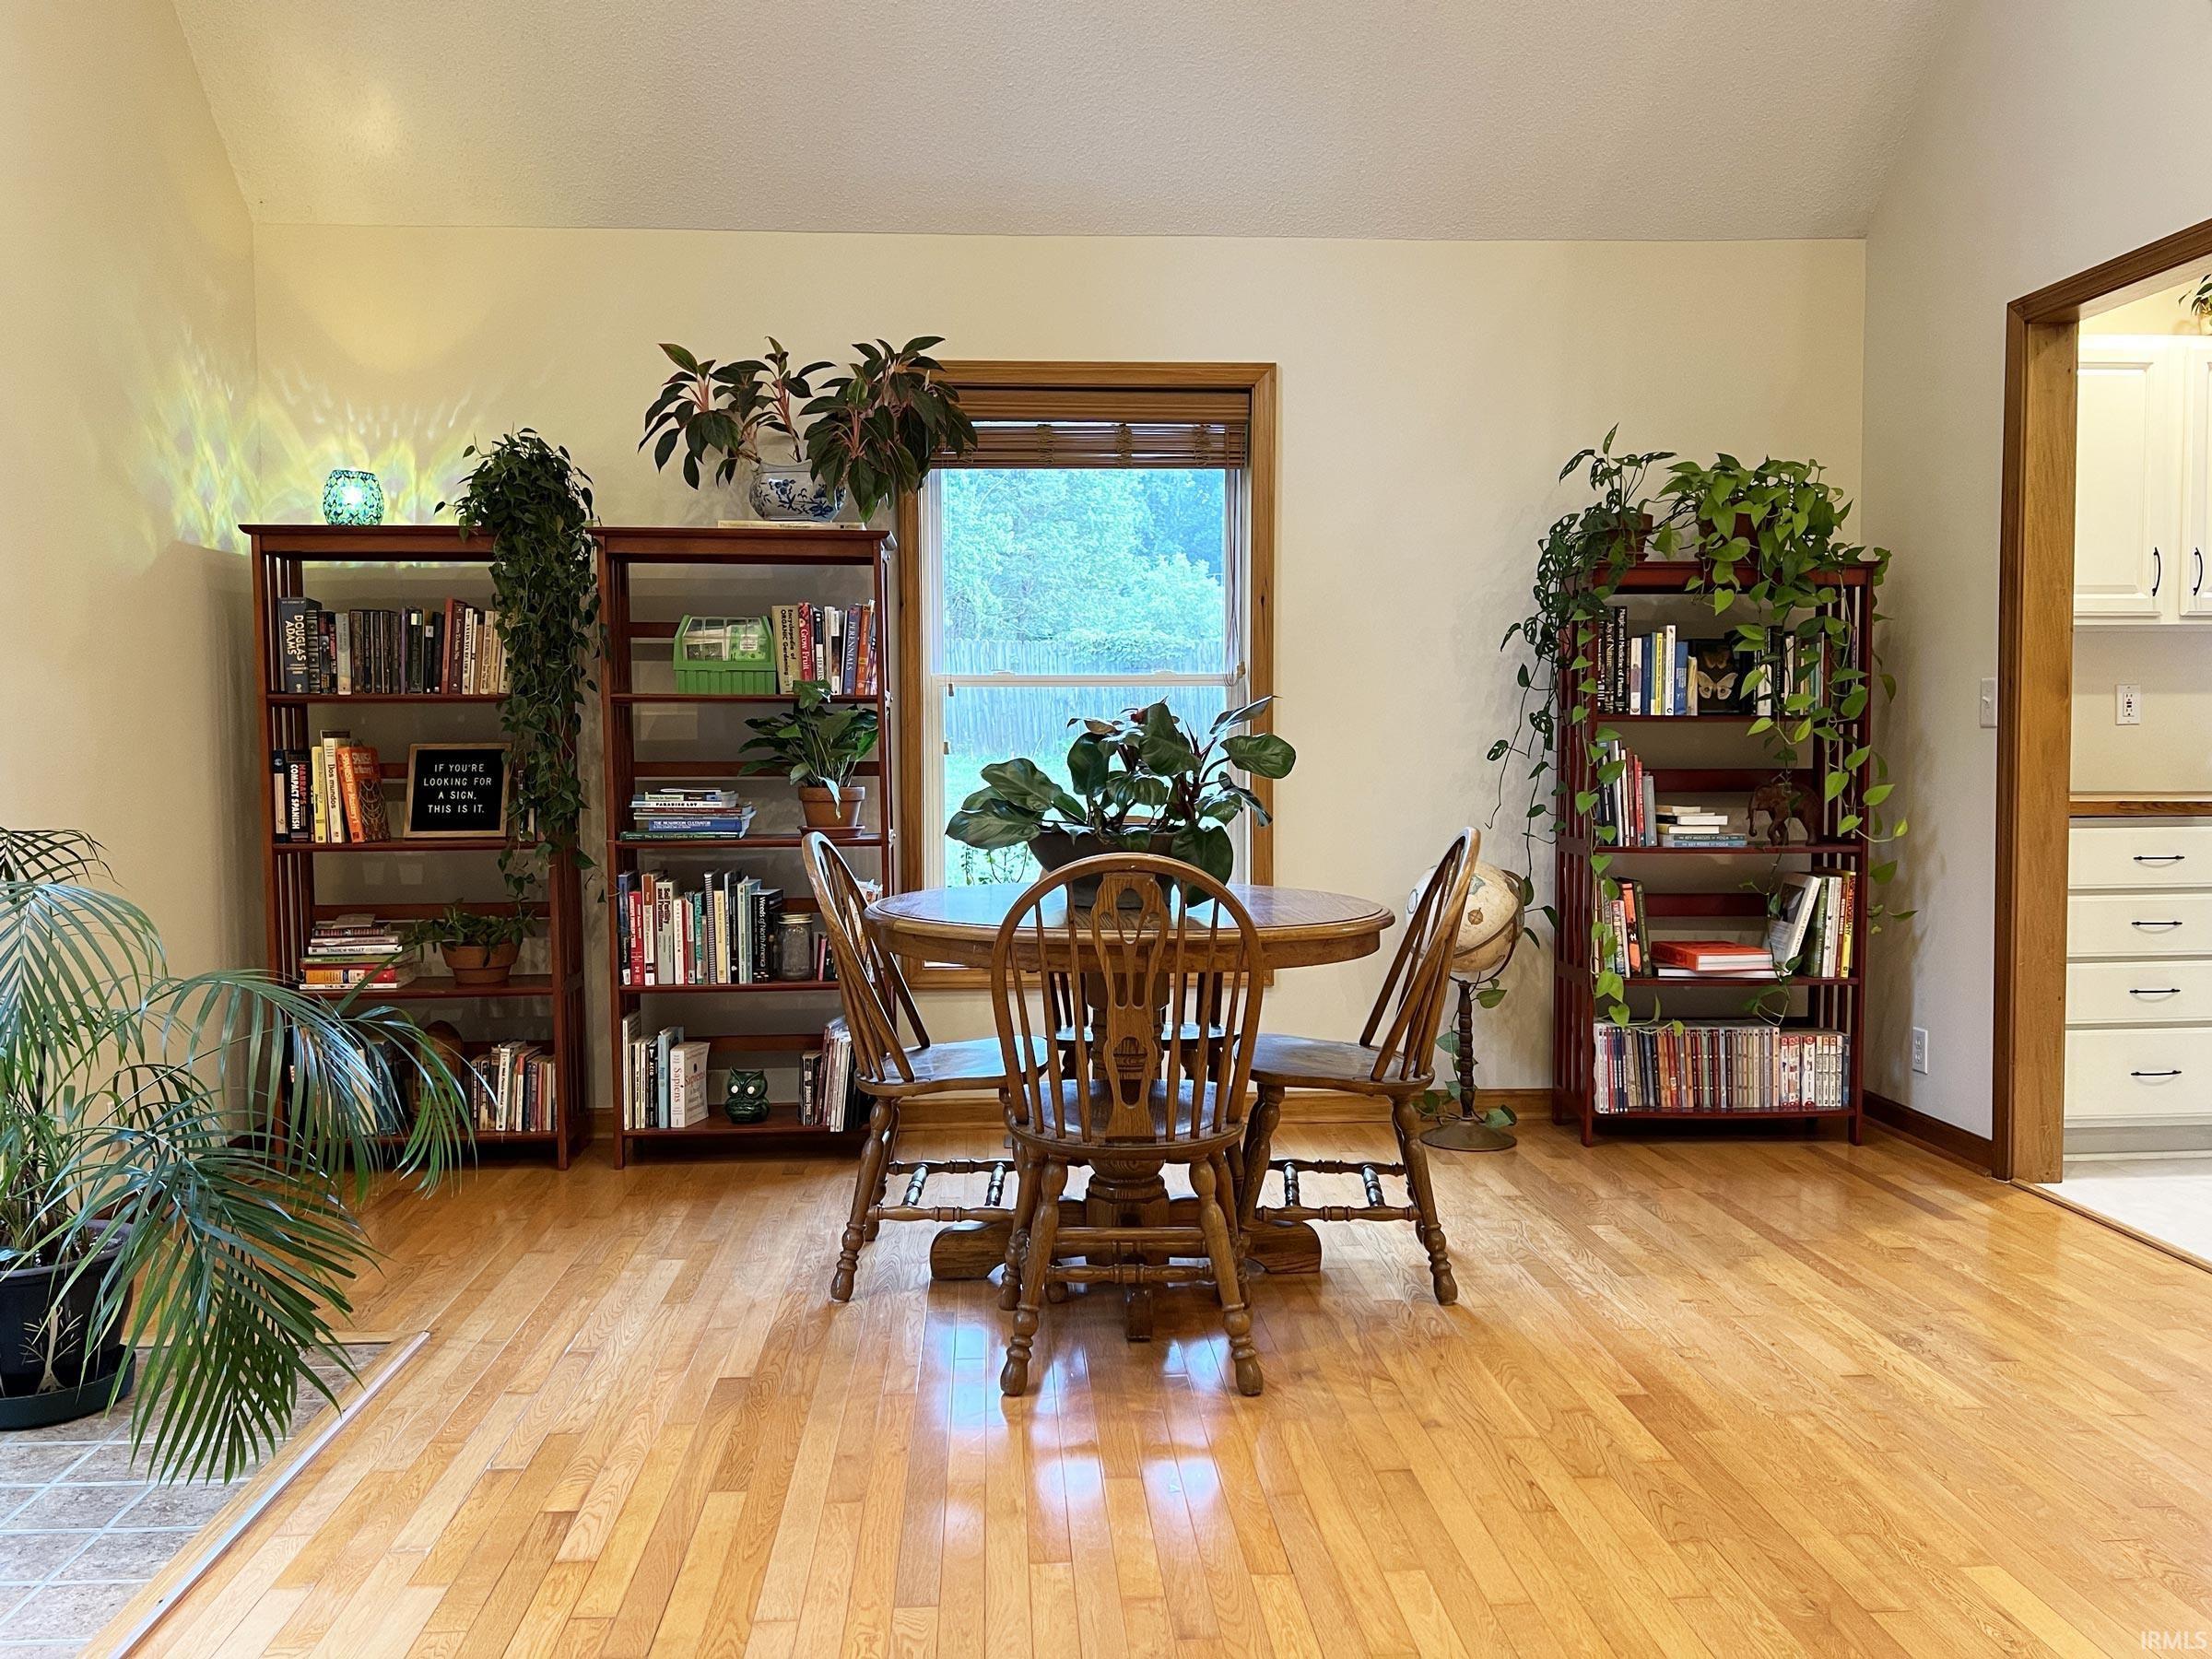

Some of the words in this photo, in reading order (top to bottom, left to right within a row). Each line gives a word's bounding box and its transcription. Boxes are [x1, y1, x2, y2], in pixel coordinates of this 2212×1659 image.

[788, 609, 797, 651] Encyclopedia
[1606, 622, 1614, 633] Joy
[1618, 608, 1626, 627] Magic
[285, 620, 296, 655] ADAMS
[294, 615, 306, 661] DOUGLAS
[846, 621, 855, 671] PERENNIALS
[290, 764, 300, 798] COMPACT
[423, 777, 467, 786] LOOKING
[473, 777, 492, 786] FOR
[434, 763, 444, 772] IF
[449, 763, 485, 772] YOU'RE
[299, 764, 307, 805] HARRAP'S
[438, 791, 444, 800] A
[450, 791, 477, 800] SIGN.
[291, 798, 300, 829] SPANISH
[427, 805, 452, 813] THIS
[458, 805, 468, 813] IS
[473, 805, 485, 813] IT.
[663, 900, 671, 924] Fertility
[672, 1067, 683, 1103] Sapiens
